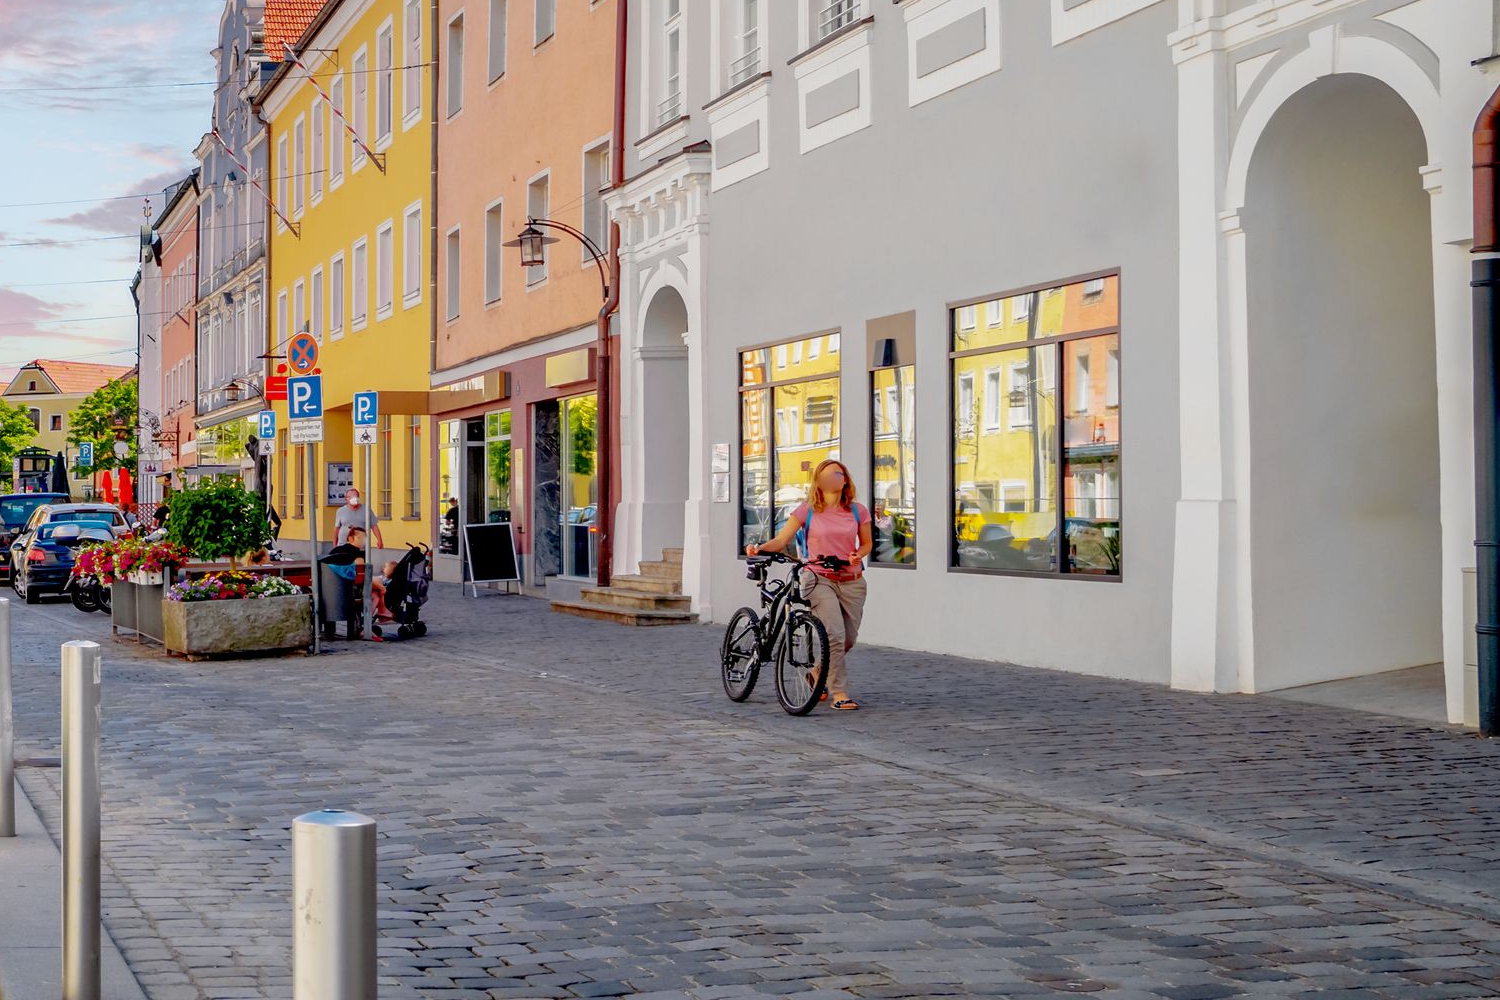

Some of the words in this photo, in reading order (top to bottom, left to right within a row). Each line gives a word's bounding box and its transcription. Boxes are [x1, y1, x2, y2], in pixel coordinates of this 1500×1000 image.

[292, 381, 312, 414] P
[357, 396, 371, 422] P
[261, 414, 271, 436] P
